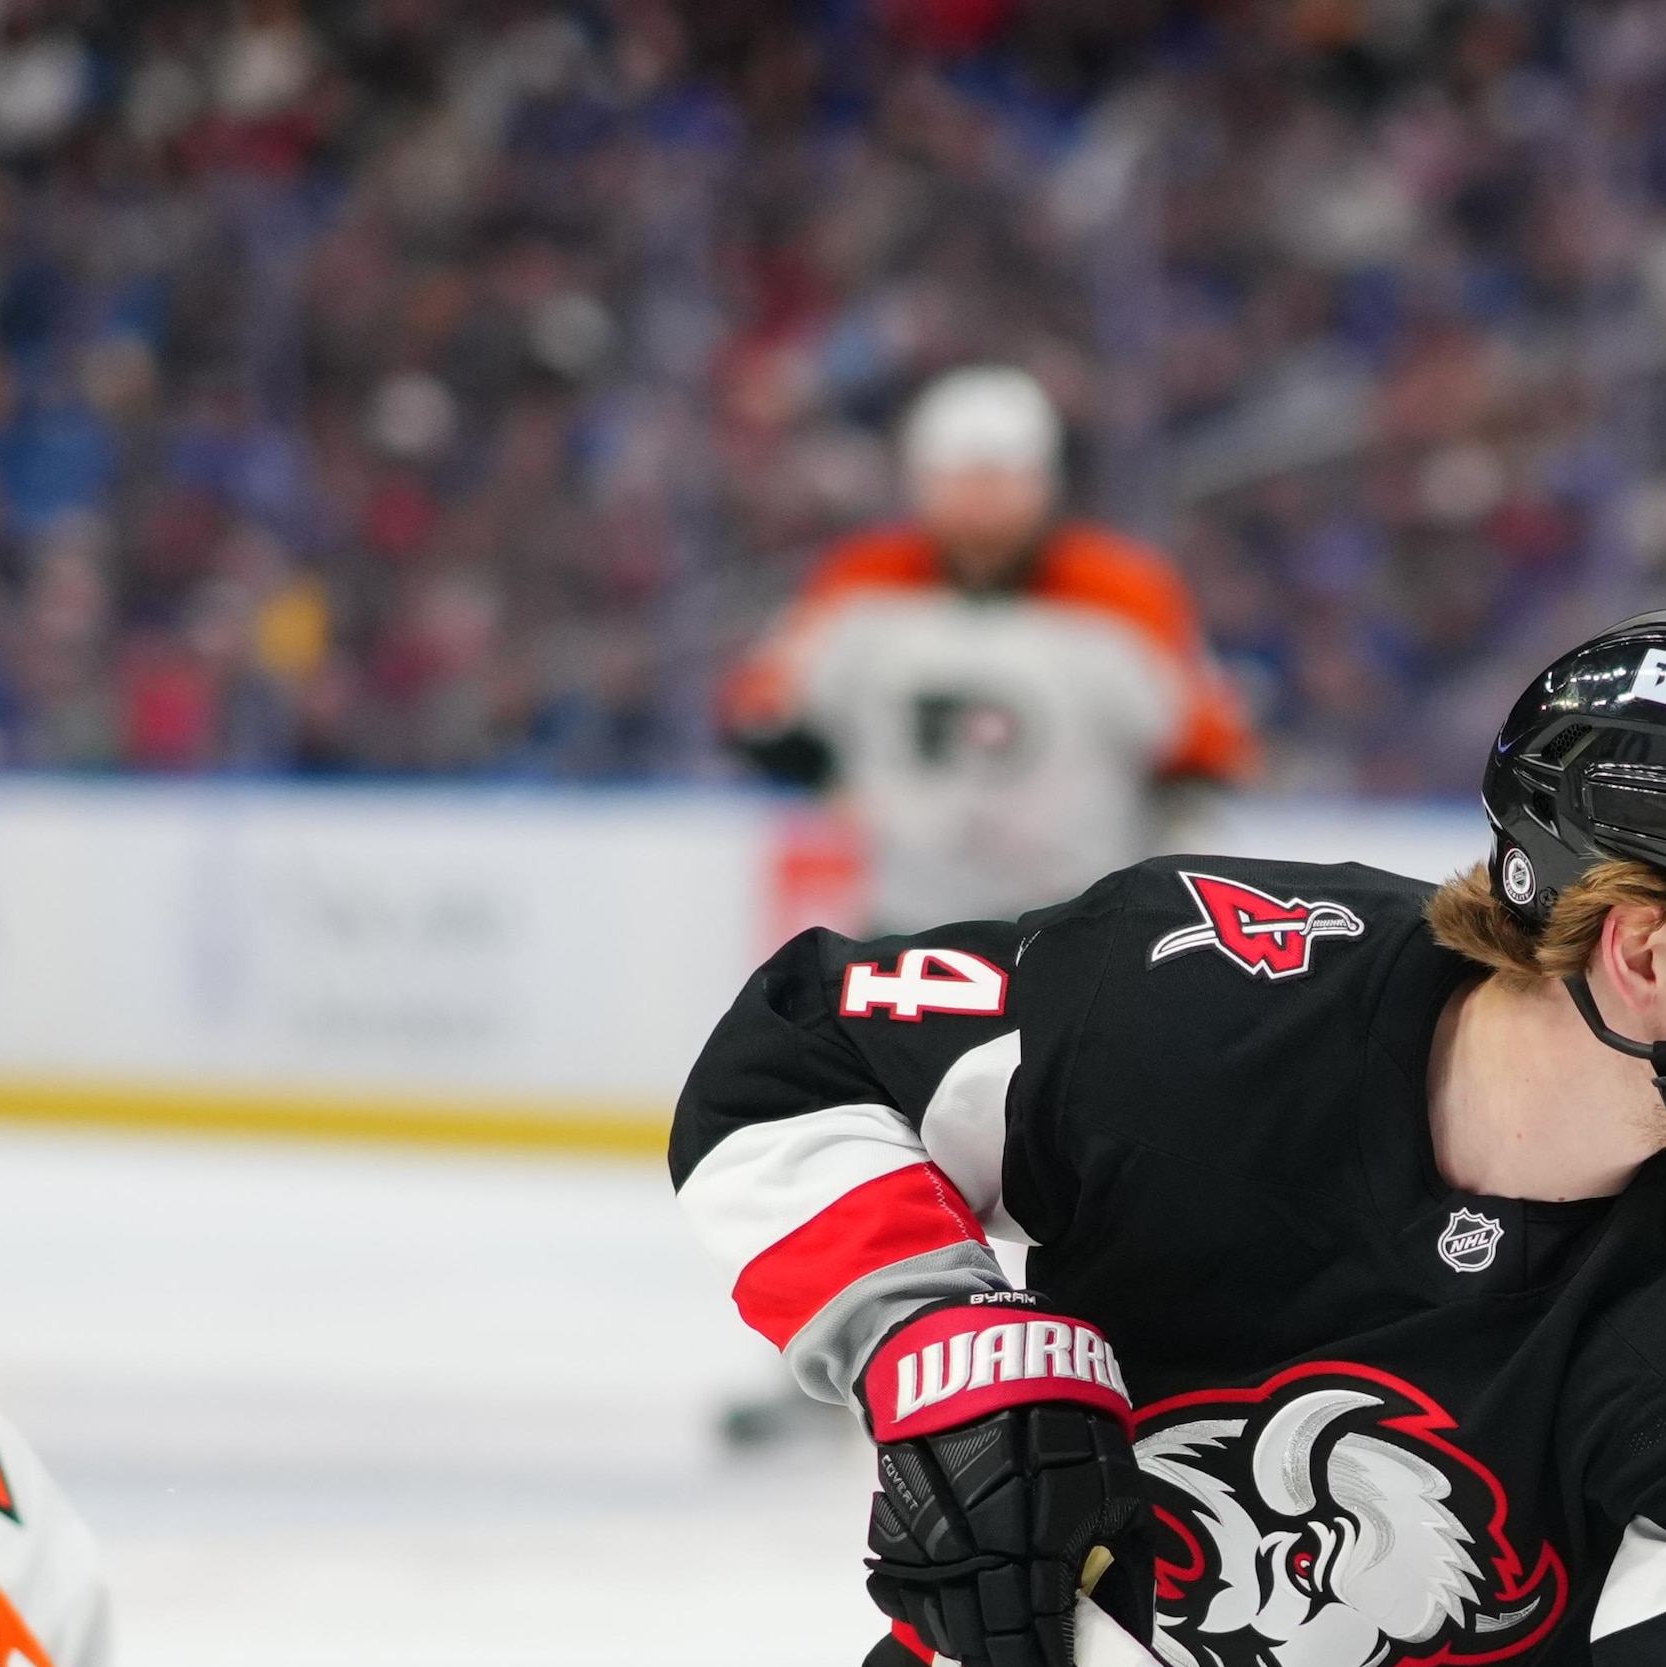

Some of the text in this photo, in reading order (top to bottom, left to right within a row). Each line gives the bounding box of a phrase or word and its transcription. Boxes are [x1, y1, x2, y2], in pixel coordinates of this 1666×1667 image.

[839, 948, 1009, 1022] 4
[1449, 1232, 1490, 1254] NHL
[970, 1290, 1037, 1305] BYRAM
[881, 1454, 919, 1511] COVERT
